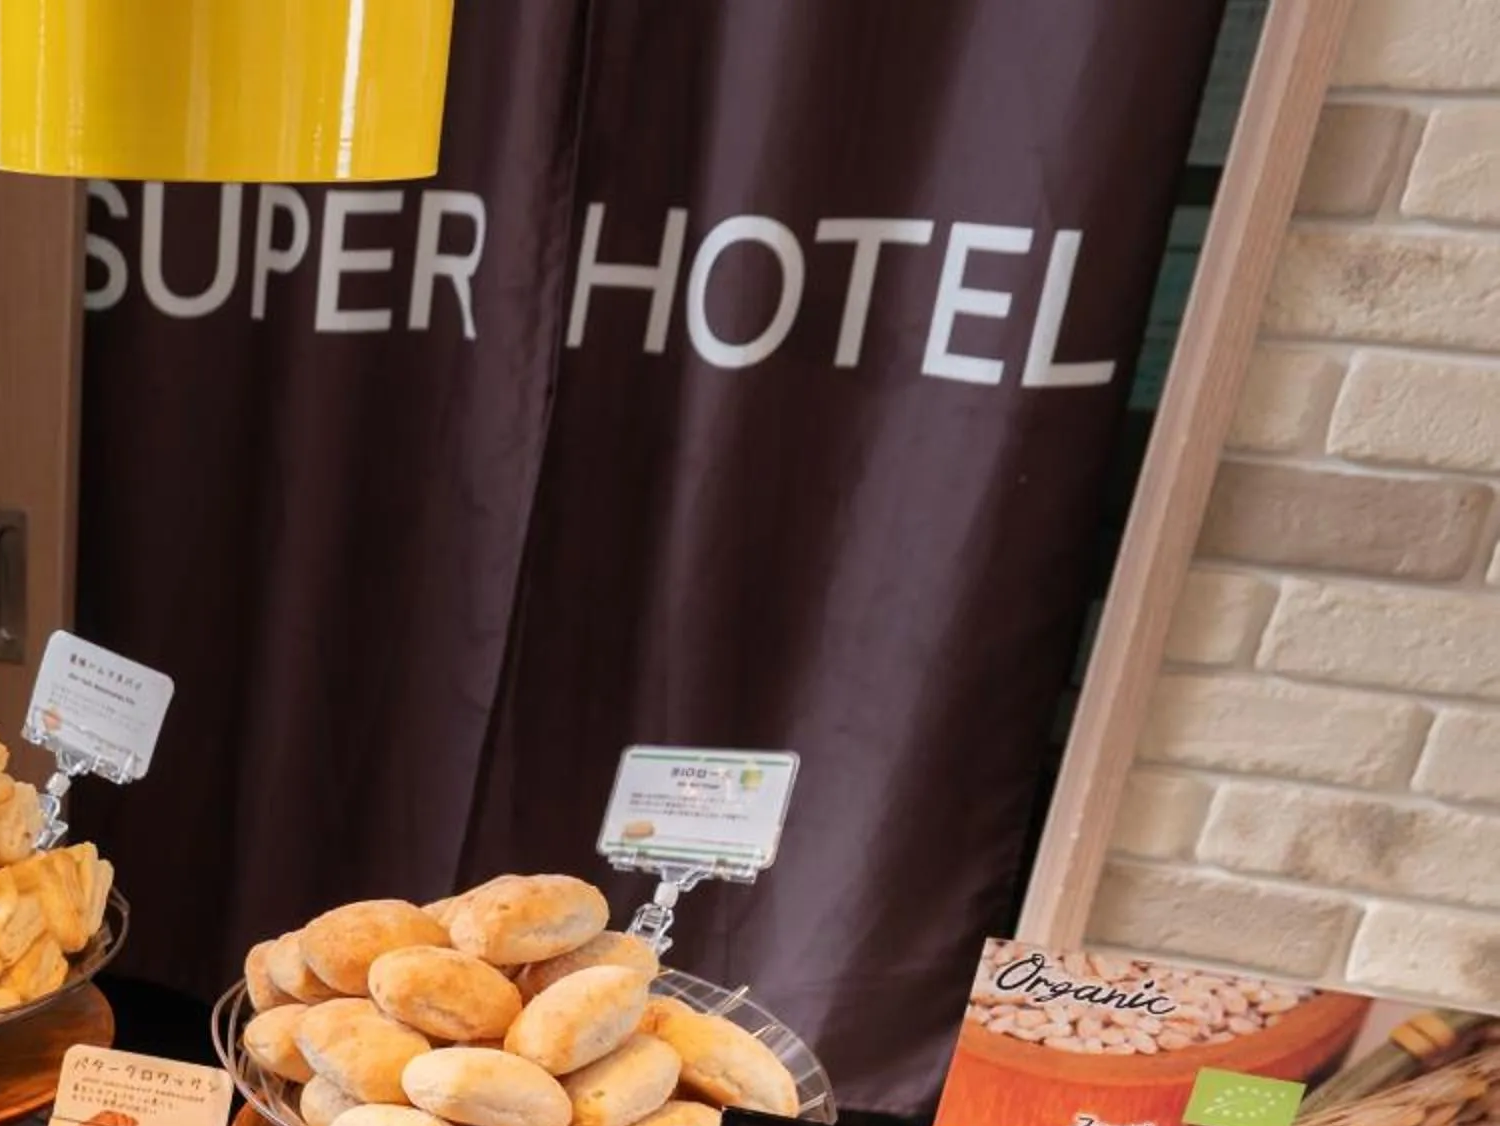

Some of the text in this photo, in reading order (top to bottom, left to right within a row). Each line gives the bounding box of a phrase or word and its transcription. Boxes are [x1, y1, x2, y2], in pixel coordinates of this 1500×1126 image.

[83, 178, 1117, 388] SUPER HOTEL
[996, 953, 1177, 1015] Organic
[73, 1056, 221, 1094] バタークロワッサン
